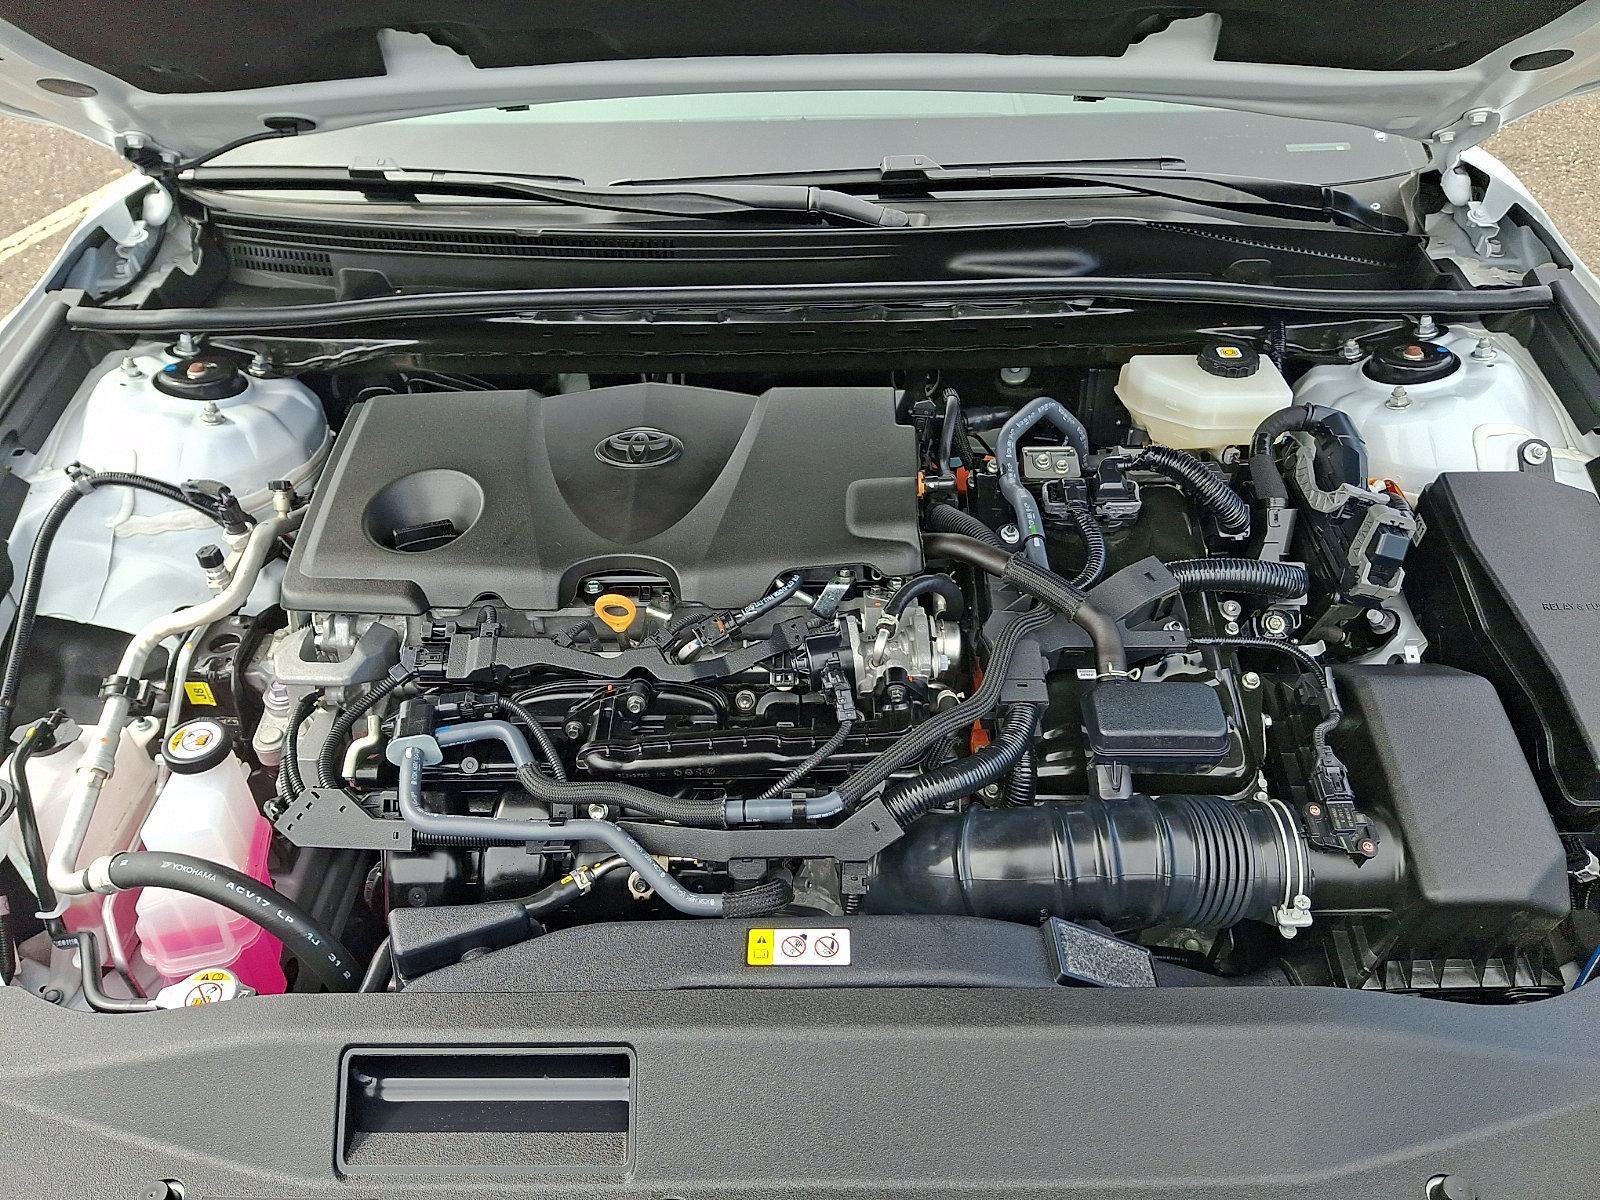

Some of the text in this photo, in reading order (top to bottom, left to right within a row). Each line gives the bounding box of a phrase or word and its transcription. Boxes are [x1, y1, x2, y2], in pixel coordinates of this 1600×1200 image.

[1541, 602, 1574, 611] RELAY
[172, 862, 217, 883] YOKOHAMA
[225, 881, 271, 907] ACV17
[276, 909, 294, 923] LP
